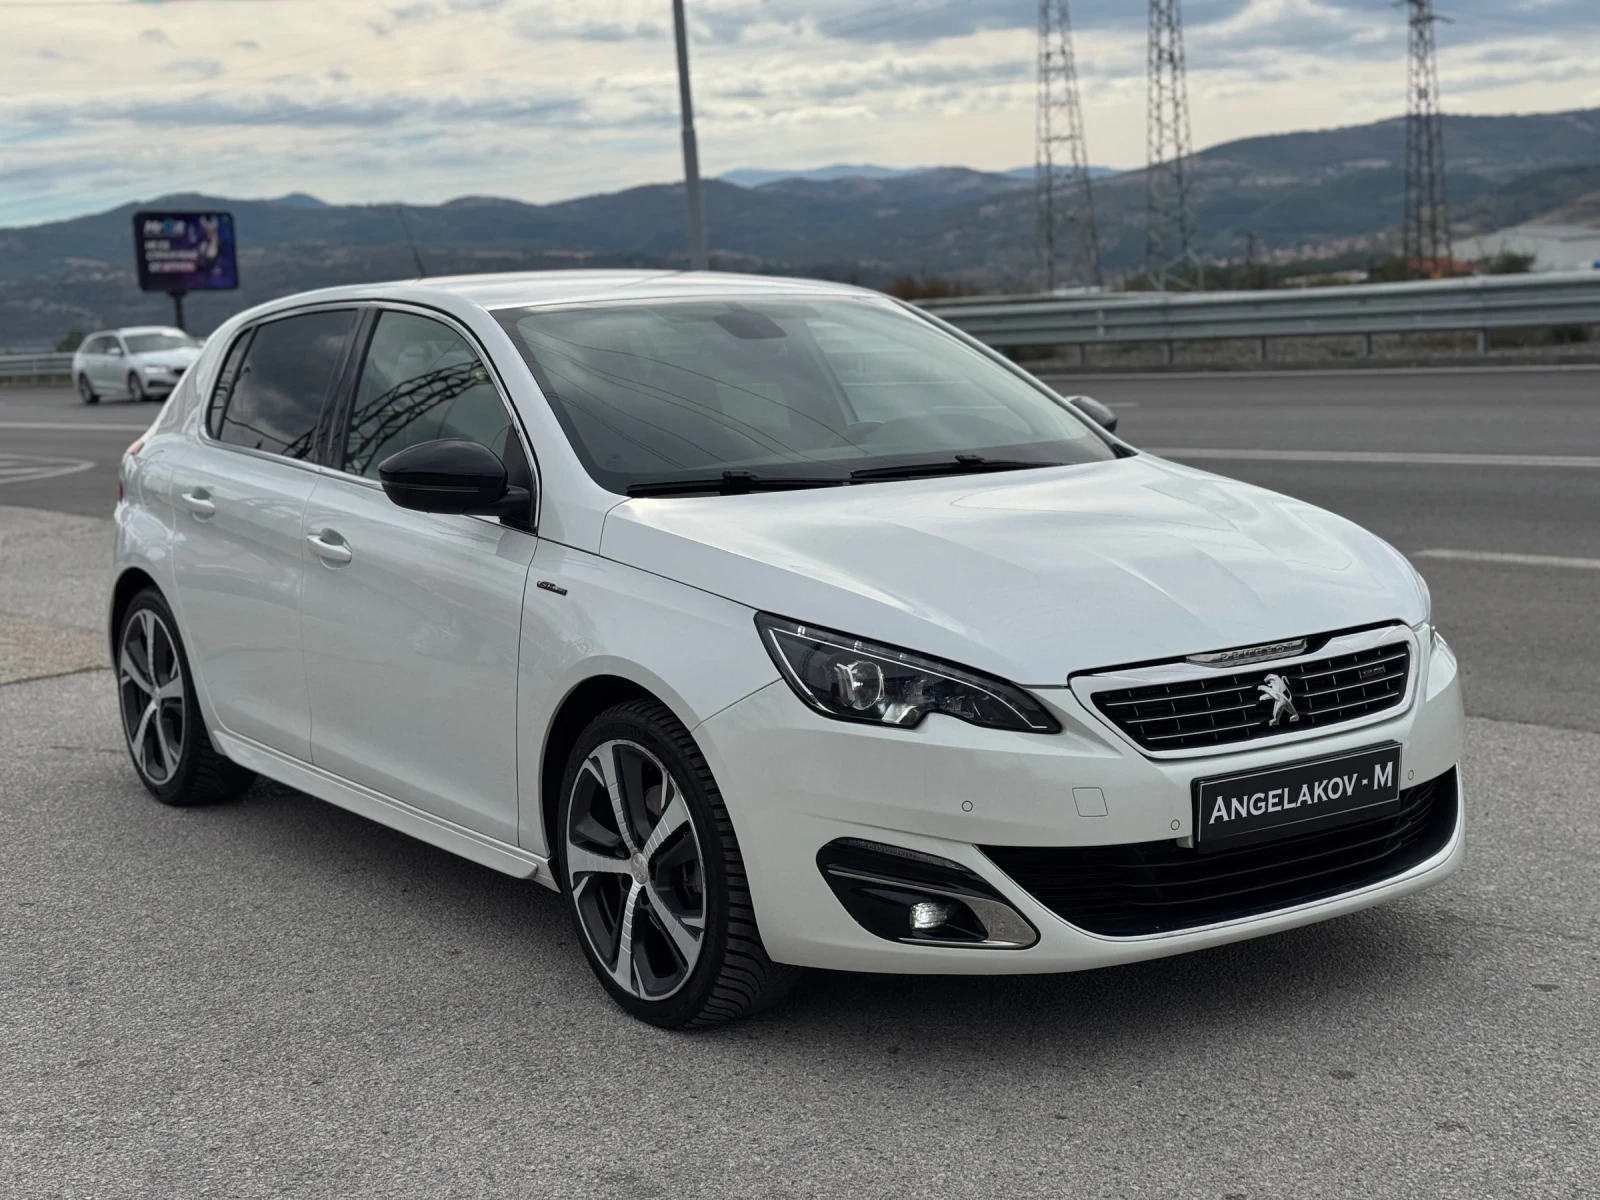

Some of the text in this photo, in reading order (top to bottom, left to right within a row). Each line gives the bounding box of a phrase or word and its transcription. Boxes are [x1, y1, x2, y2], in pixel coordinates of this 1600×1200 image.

[1220, 642, 1294, 662] PEUGEOT
[1208, 773, 1358, 825] ANGELAKOV
[1373, 761, 1394, 790] M
